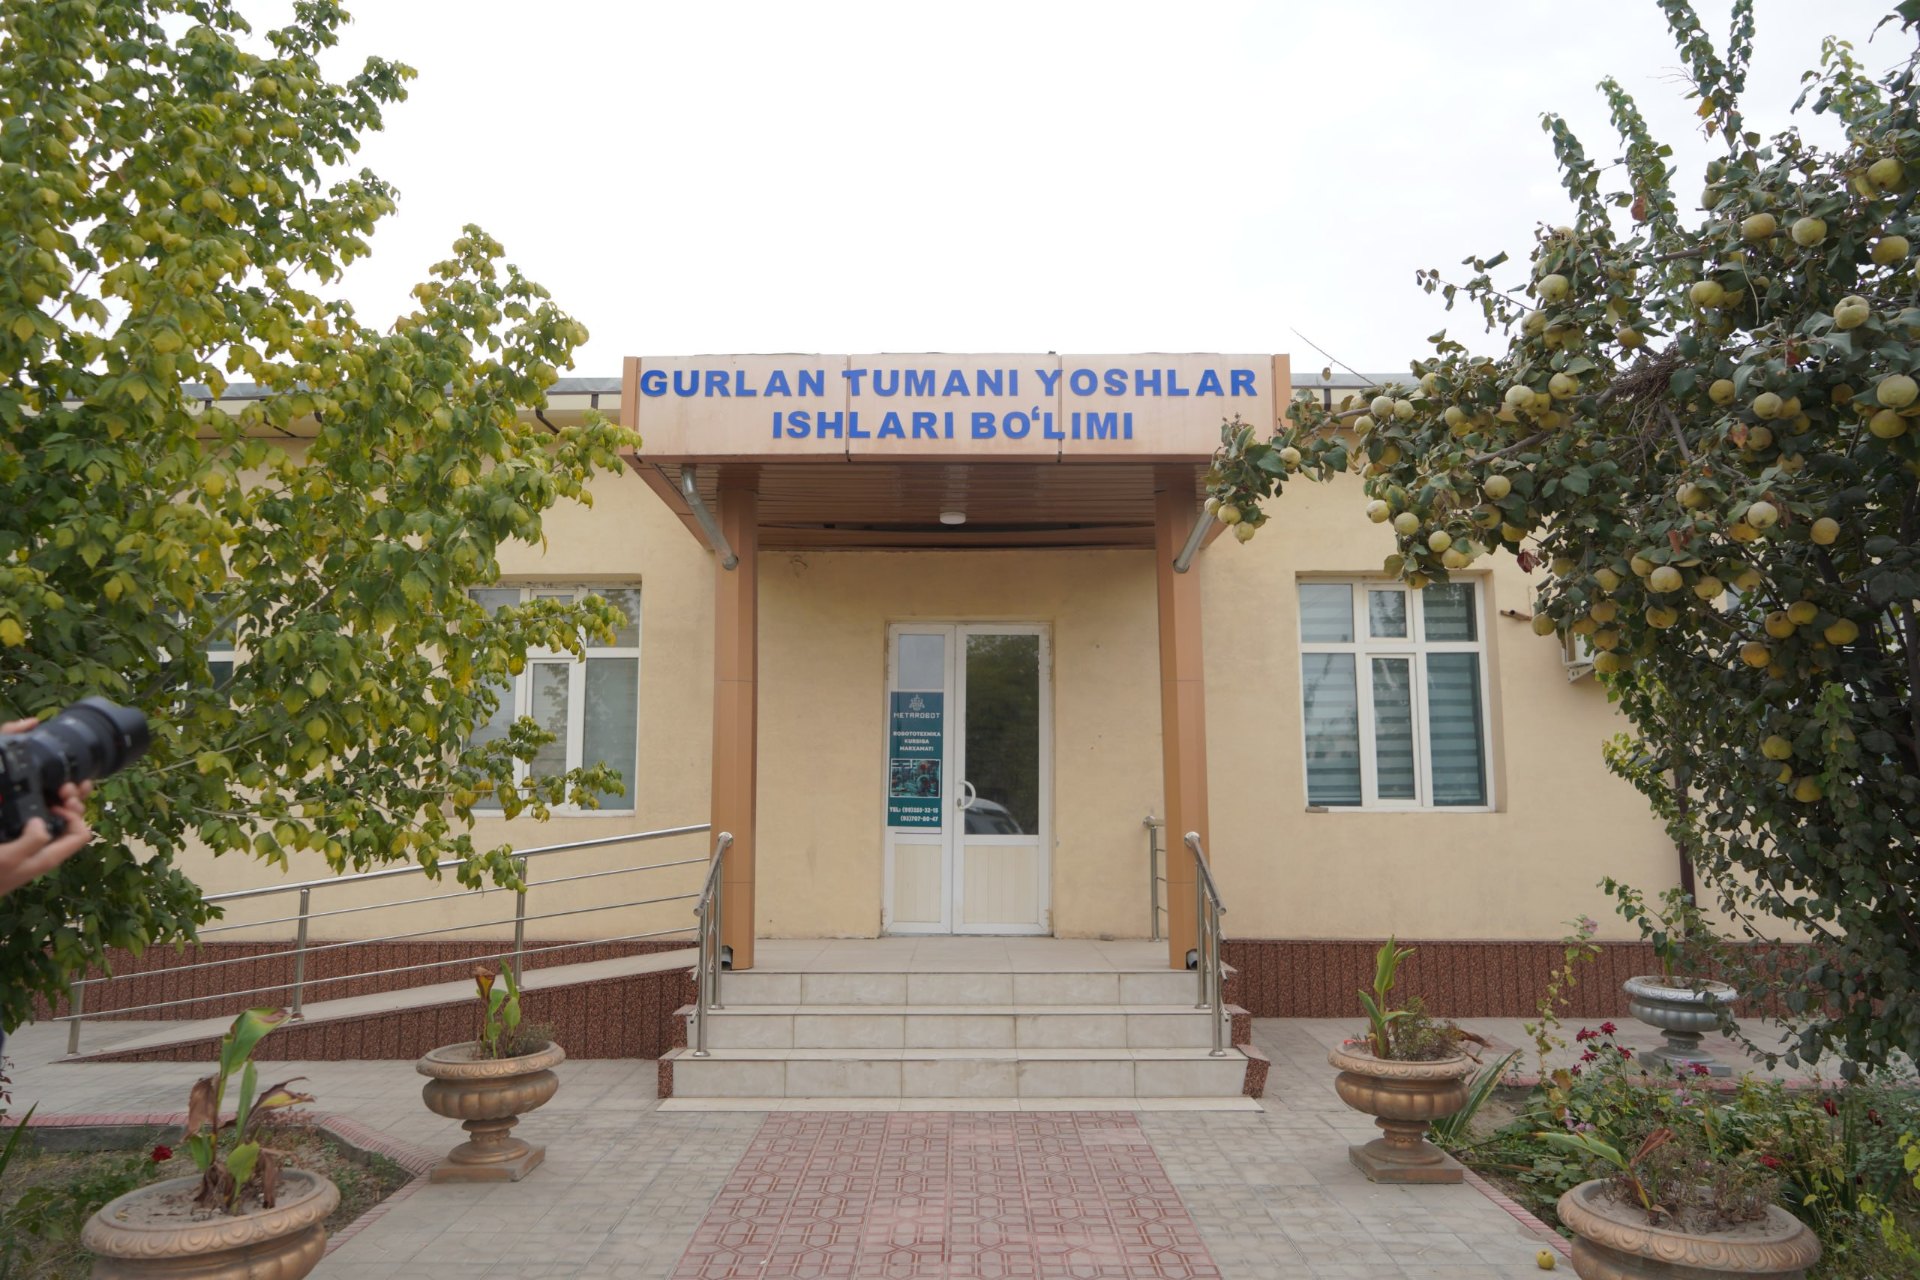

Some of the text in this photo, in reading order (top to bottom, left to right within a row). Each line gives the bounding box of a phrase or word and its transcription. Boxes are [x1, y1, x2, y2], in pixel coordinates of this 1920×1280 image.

[640, 368, 1257, 397] GURLAN TUMANI YOSHLAR
[773, 411, 954, 439] ISHLARI
